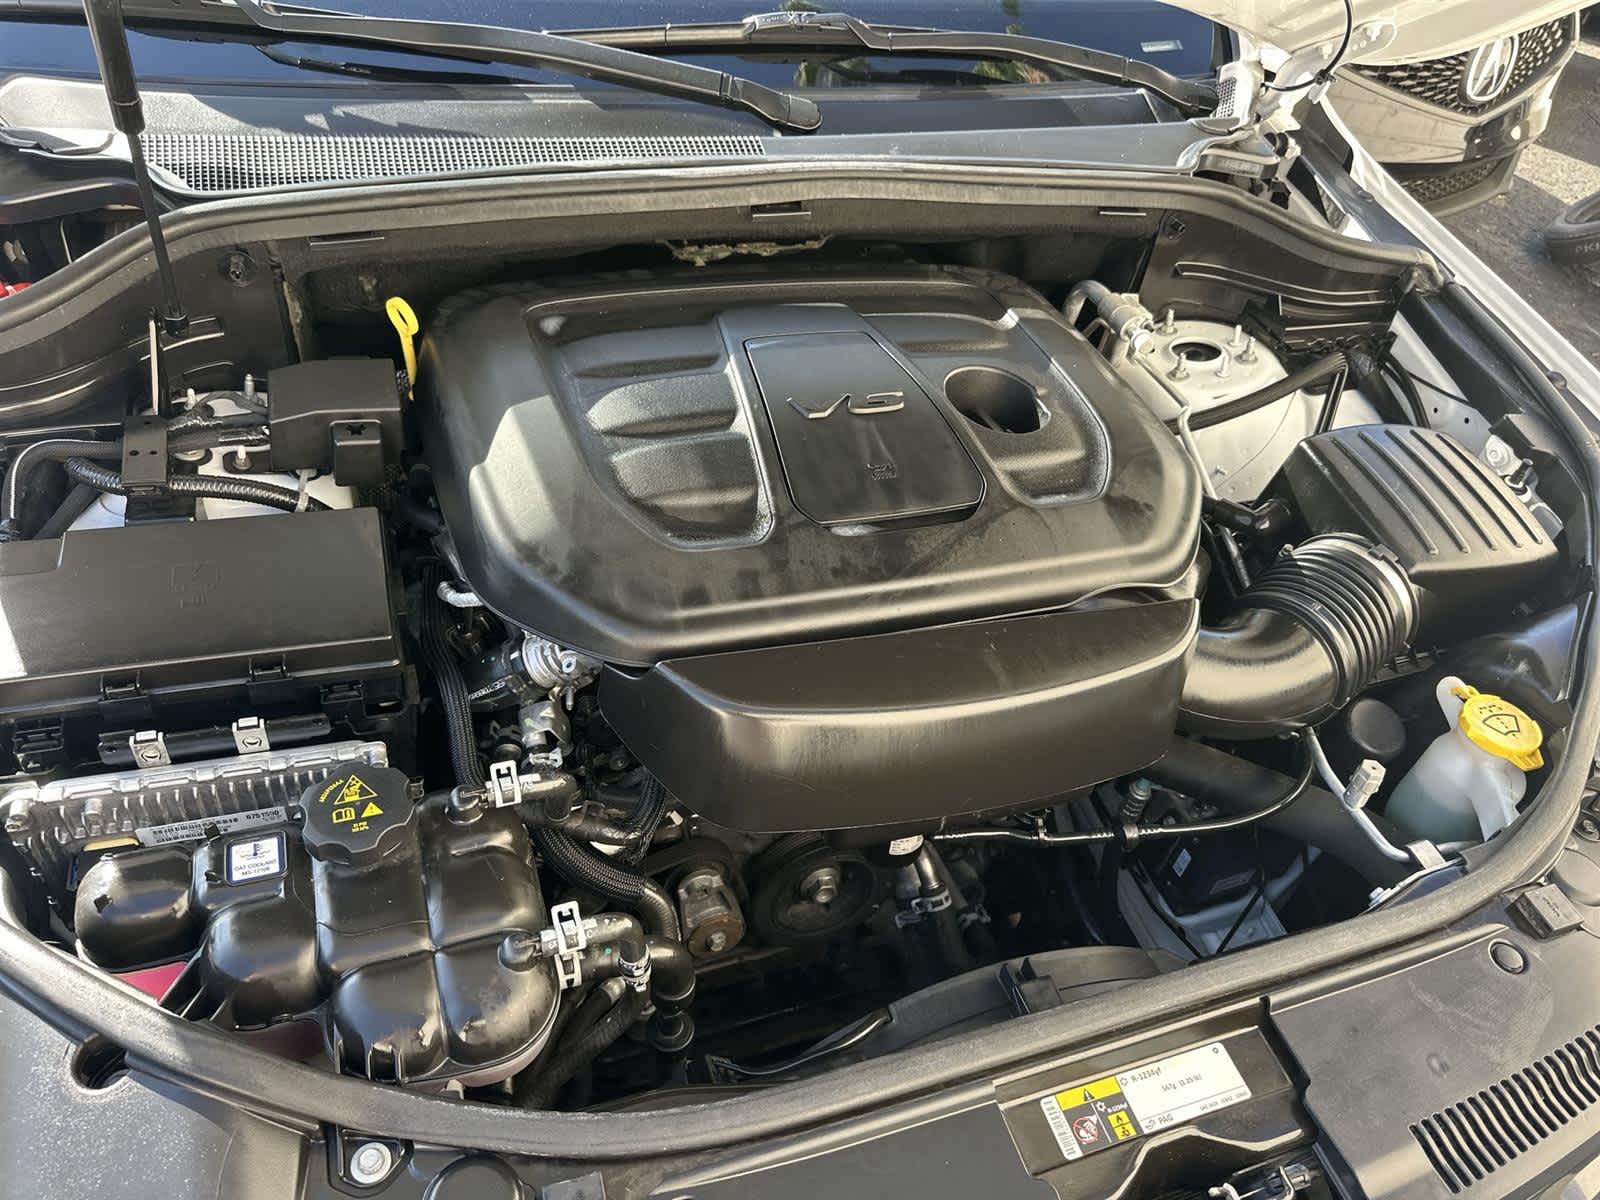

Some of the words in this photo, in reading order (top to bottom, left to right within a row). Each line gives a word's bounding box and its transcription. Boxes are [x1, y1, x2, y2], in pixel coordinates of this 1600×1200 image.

[785, 391, 905, 419] V6
[247, 859, 277, 869] COOLANT
[1158, 1113, 1174, 1125] PAG
